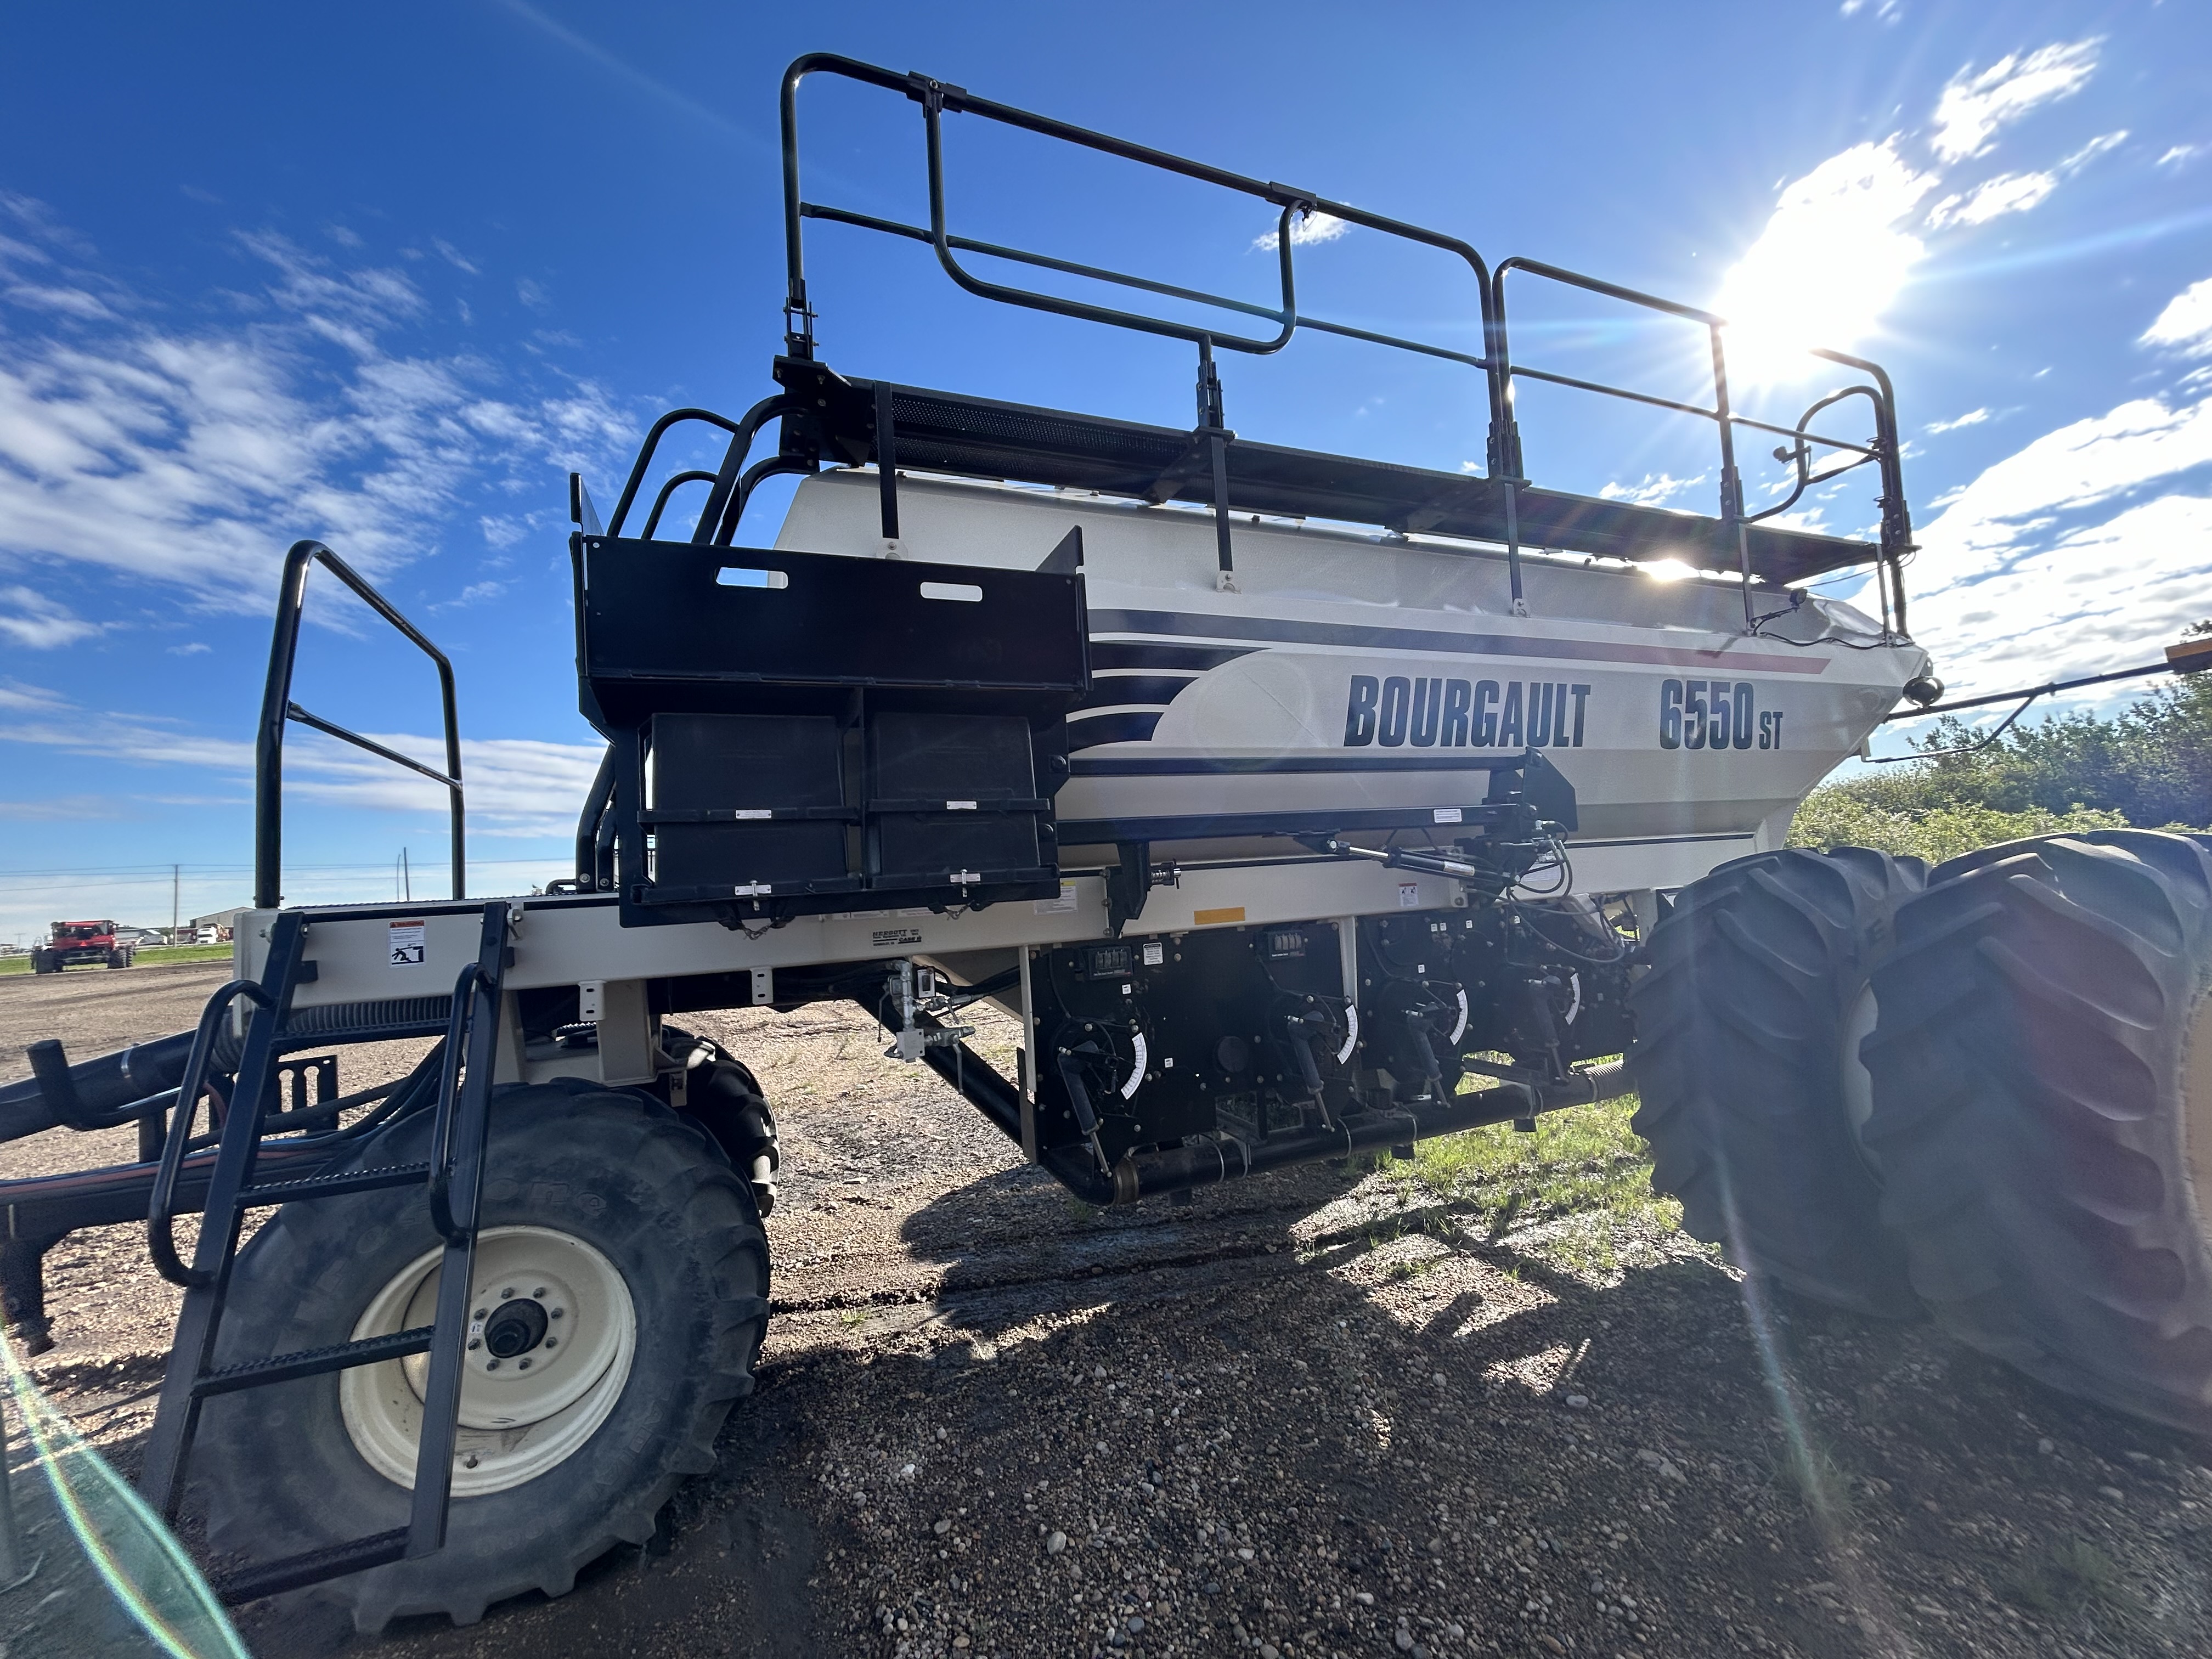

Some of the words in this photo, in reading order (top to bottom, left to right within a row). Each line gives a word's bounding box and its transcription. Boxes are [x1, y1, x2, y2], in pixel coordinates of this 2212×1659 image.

[1344, 675, 1590, 747] BOURGAULT
[1660, 679, 1753, 749] 6550
[1759, 711, 1783, 749] ST
